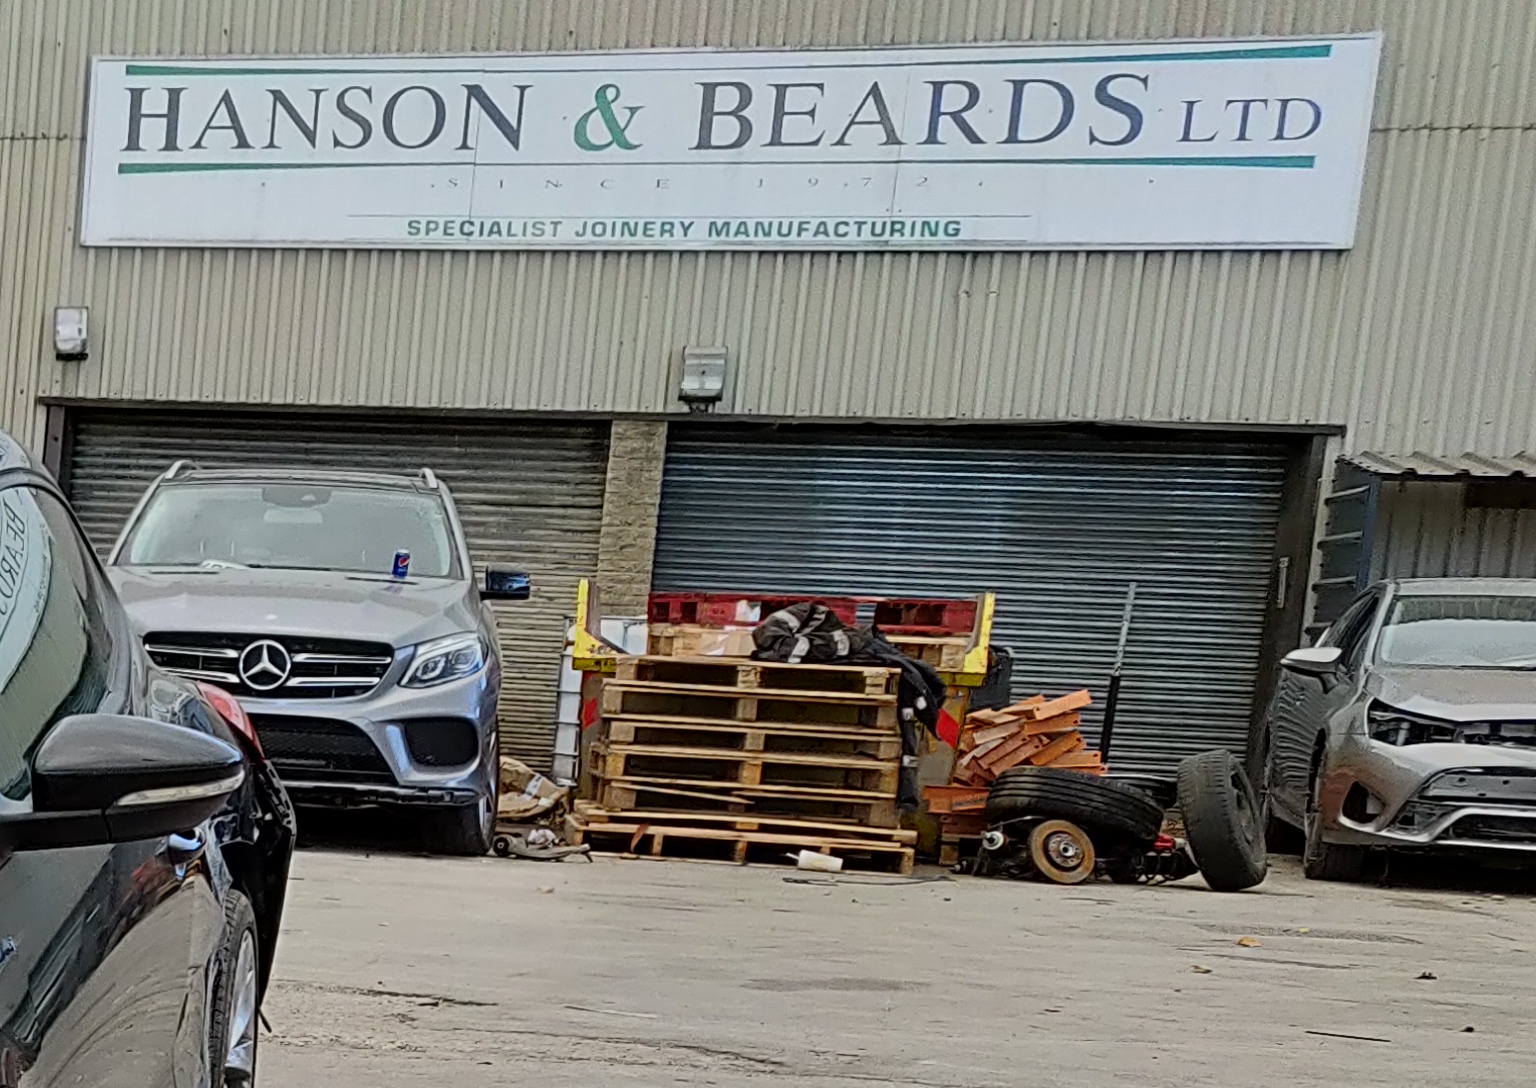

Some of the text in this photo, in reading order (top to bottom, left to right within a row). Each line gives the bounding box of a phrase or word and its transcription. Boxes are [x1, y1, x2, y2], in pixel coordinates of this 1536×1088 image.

[119, 73, 1323, 152] HANSON & BEARDS LTD
[406, 219, 963, 239] SPECIALIST JOINERY MANUFACTURING
